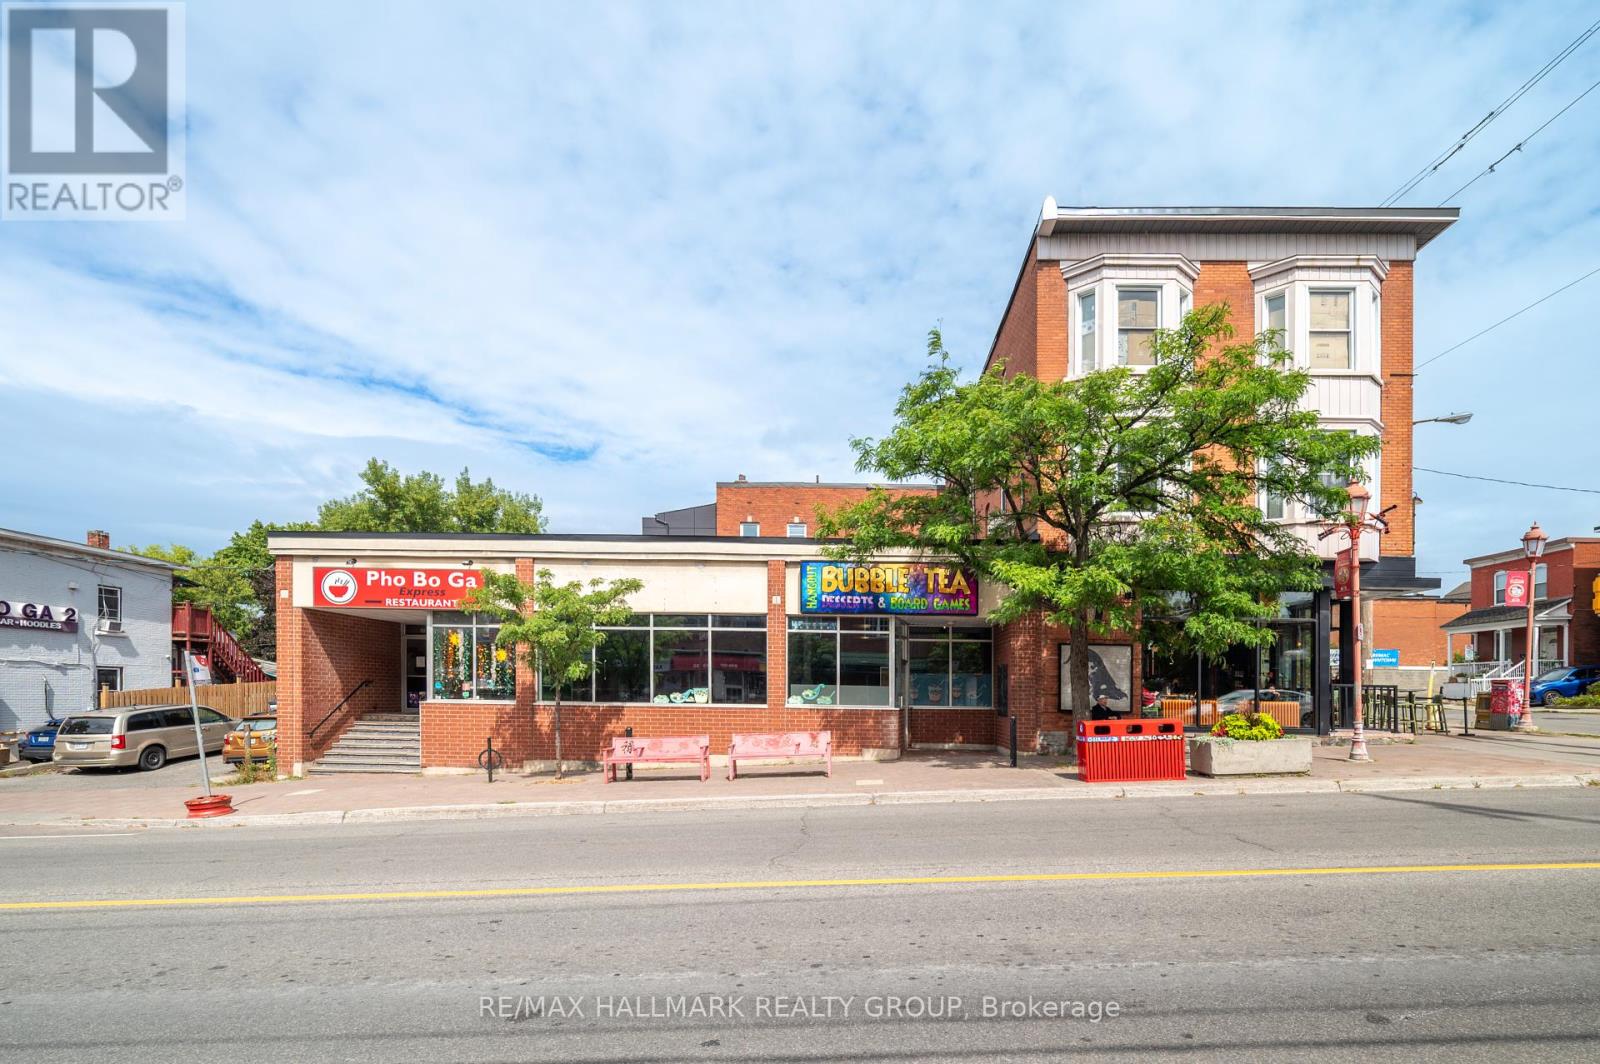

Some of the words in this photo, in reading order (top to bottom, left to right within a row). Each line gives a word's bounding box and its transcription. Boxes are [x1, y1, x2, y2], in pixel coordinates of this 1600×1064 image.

[366, 571, 406, 587] Pho
[413, 571, 441, 587] Bo
[448, 571, 477, 588] Ga
[806, 565, 818, 609] HANGOUT
[821, 565, 910, 593] BUBBLE
[924, 566, 971, 595] TEA
[399, 587, 446, 598] Express
[385, 598, 458, 608] RESTAURANT
[821, 595, 874, 609] DESSERTS
[878, 597, 886, 609] &
[890, 597, 928, 610] BOARD
[933, 597, 970, 610] GAMES
[22, 603, 53, 620] GA
[65, 607, 76, 622] 2
